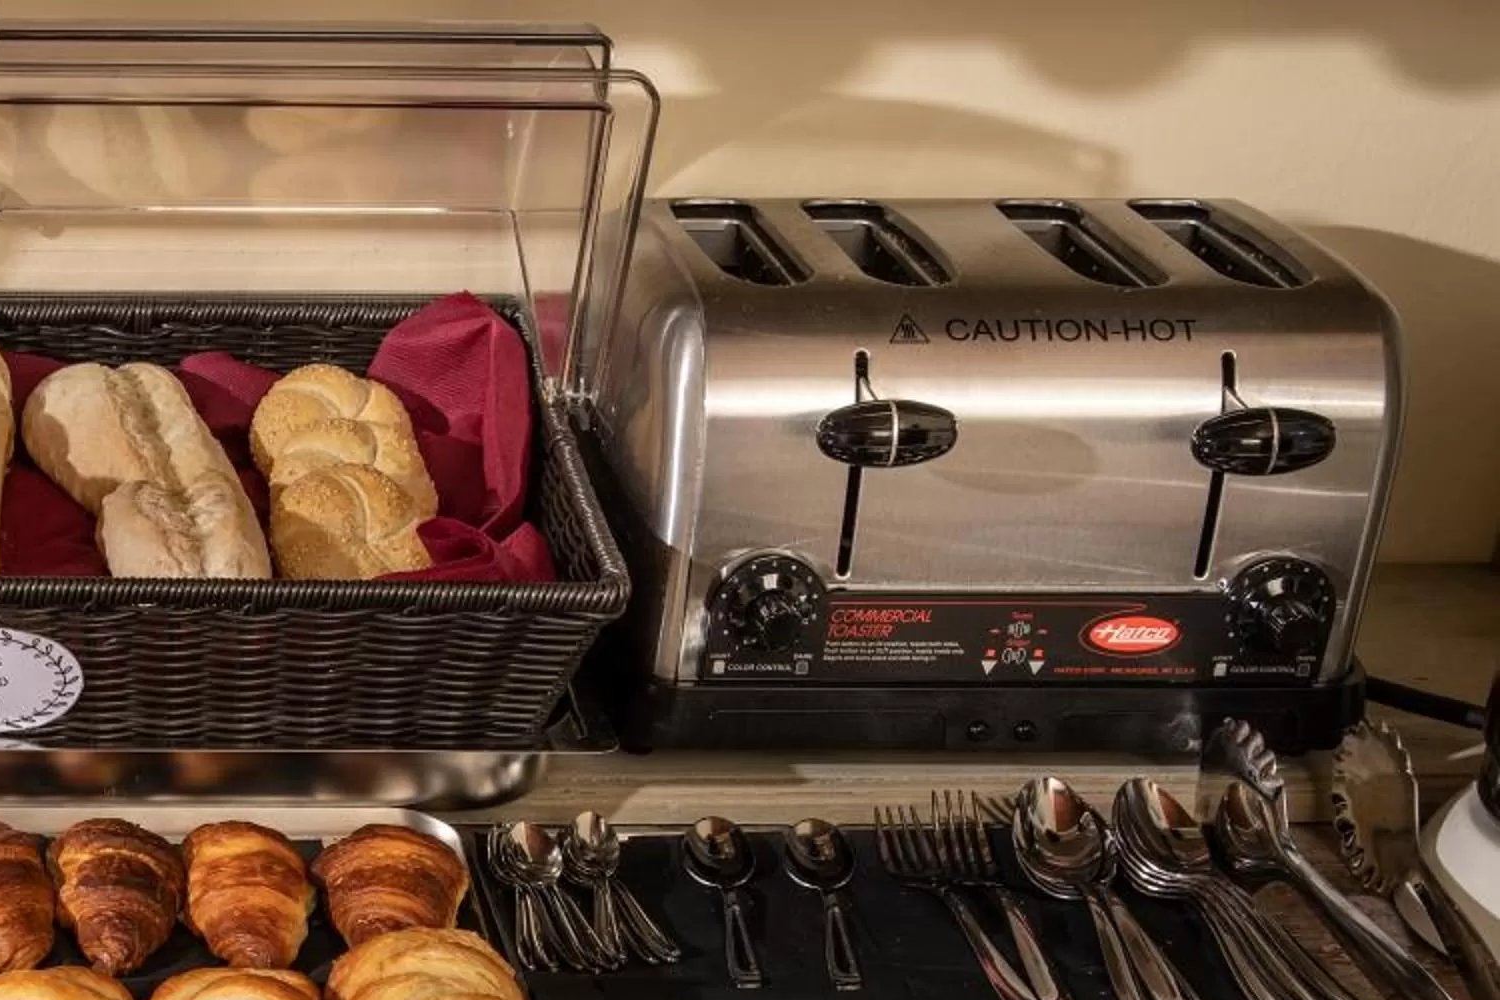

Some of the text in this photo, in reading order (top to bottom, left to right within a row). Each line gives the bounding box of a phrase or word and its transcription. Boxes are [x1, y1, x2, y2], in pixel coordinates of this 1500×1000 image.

[945, 318, 1197, 342] CAUTION-HOT
[831, 609, 933, 623] COMMERCIAL
[827, 624, 893, 638] TOASTER
[1094, 623, 1173, 644] Hatco
